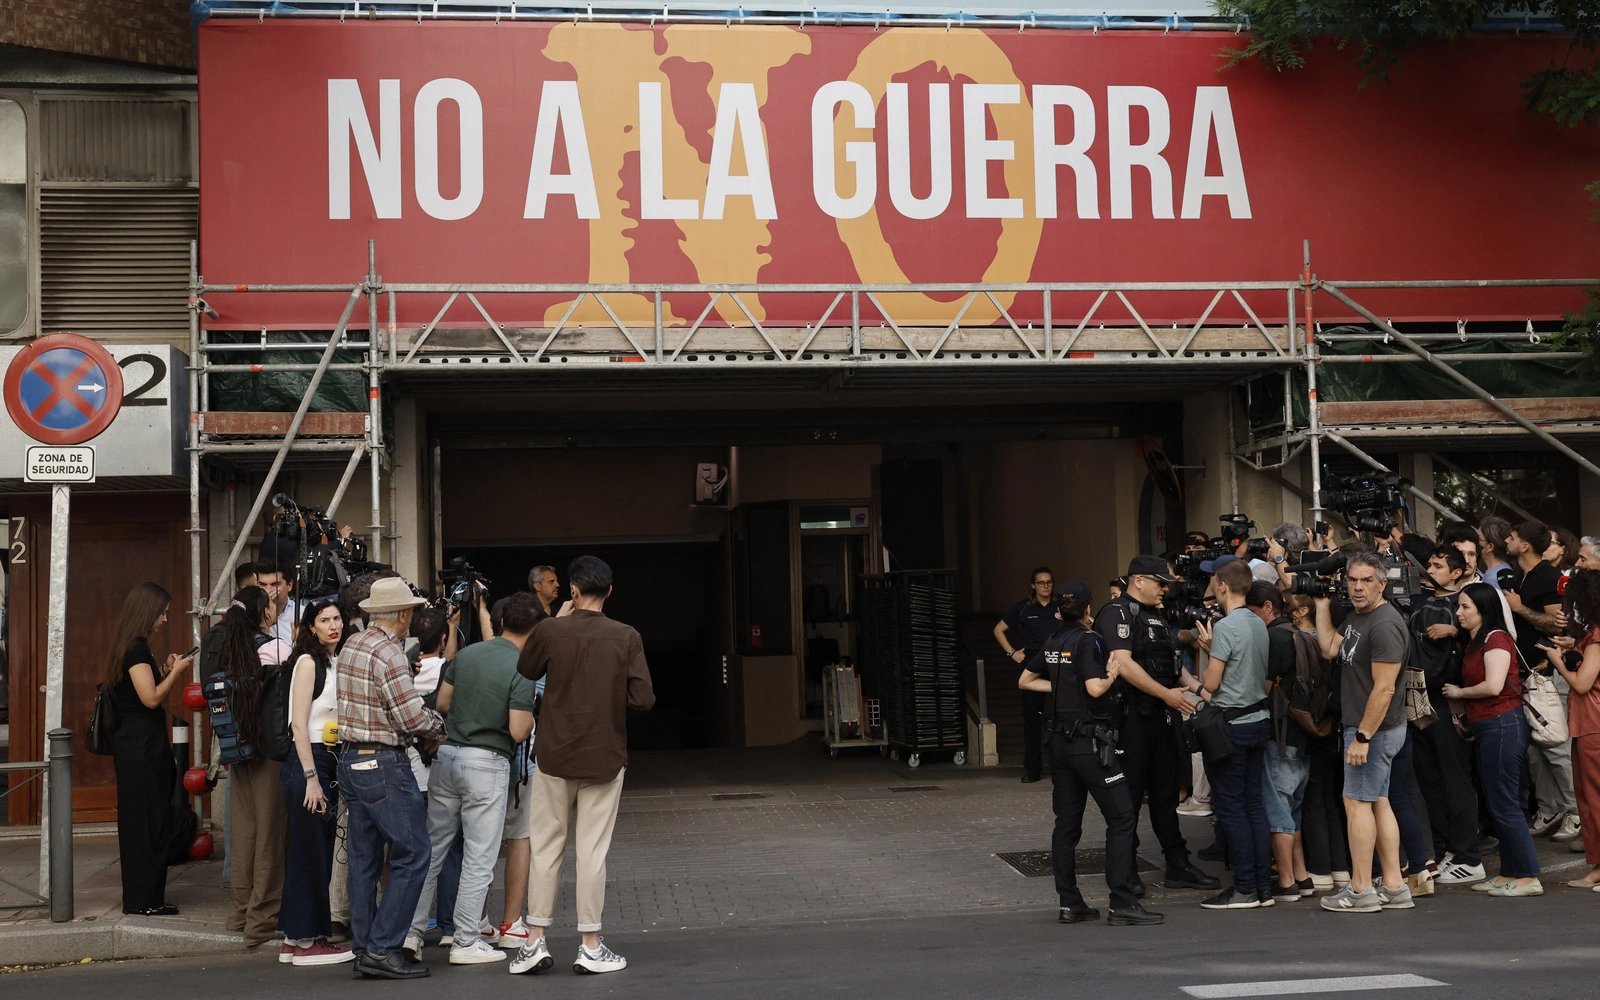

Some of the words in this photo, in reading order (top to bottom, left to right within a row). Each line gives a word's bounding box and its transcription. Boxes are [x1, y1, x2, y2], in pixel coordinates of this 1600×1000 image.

[327, 77, 484, 221] NO
[523, 80, 601, 219] A
[638, 81, 778, 220] LA
[811, 80, 1253, 220] GUERRA
[112, 353, 168, 406] 2
[32, 465, 89, 474] SEGURIDAD
[38, 454, 66, 463] ZONA
[69, 454, 83, 463] DE
